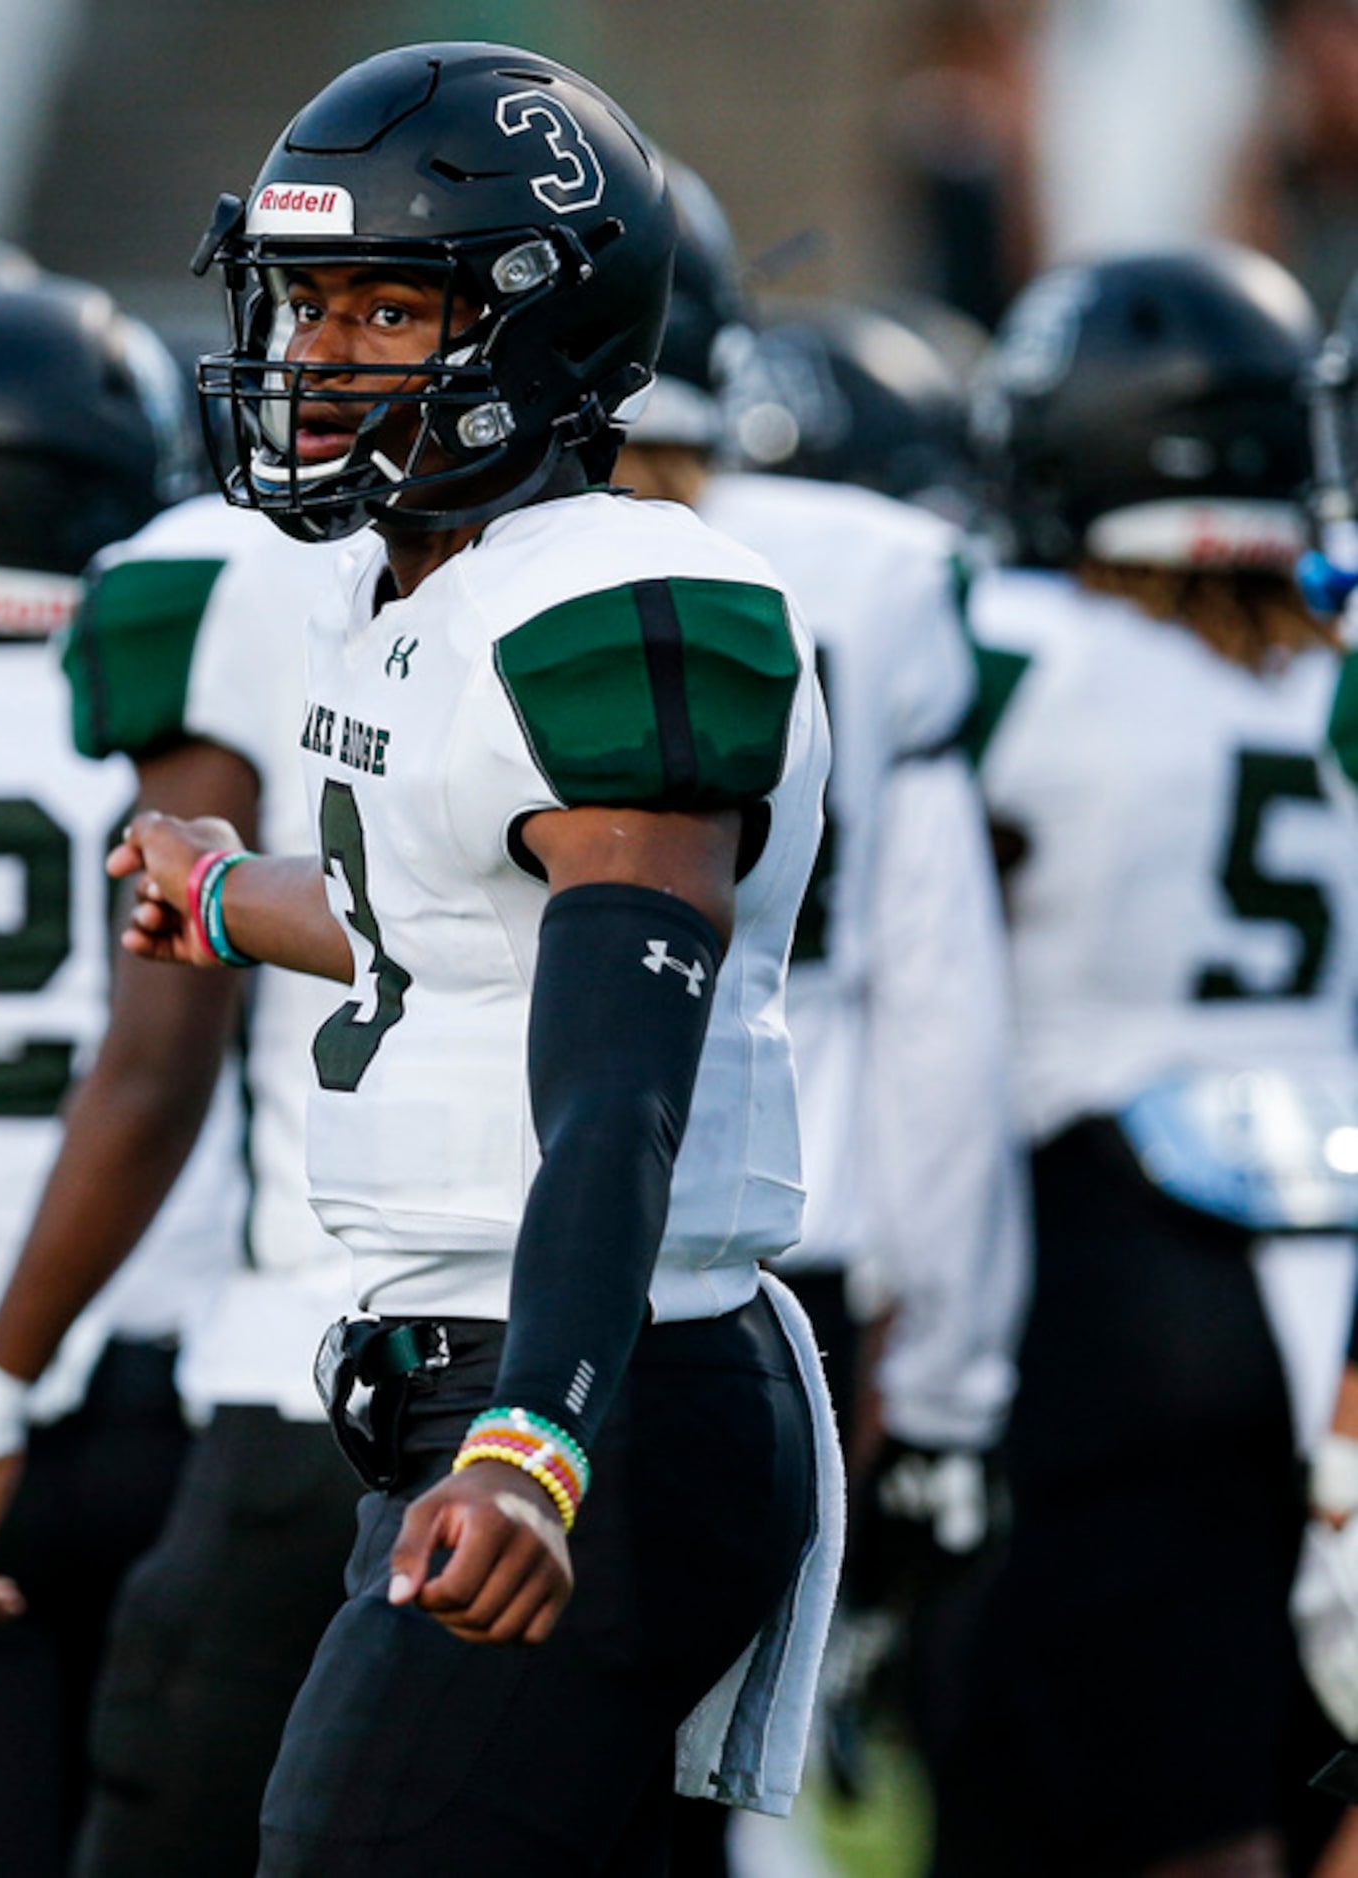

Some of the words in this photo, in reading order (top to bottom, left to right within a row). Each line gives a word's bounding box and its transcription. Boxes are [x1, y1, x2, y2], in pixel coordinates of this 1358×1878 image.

[260, 188, 337, 213] Riddell
[496, 90, 604, 213] 3
[311, 777, 413, 1091] 3
[1194, 748, 1332, 1003] 5
